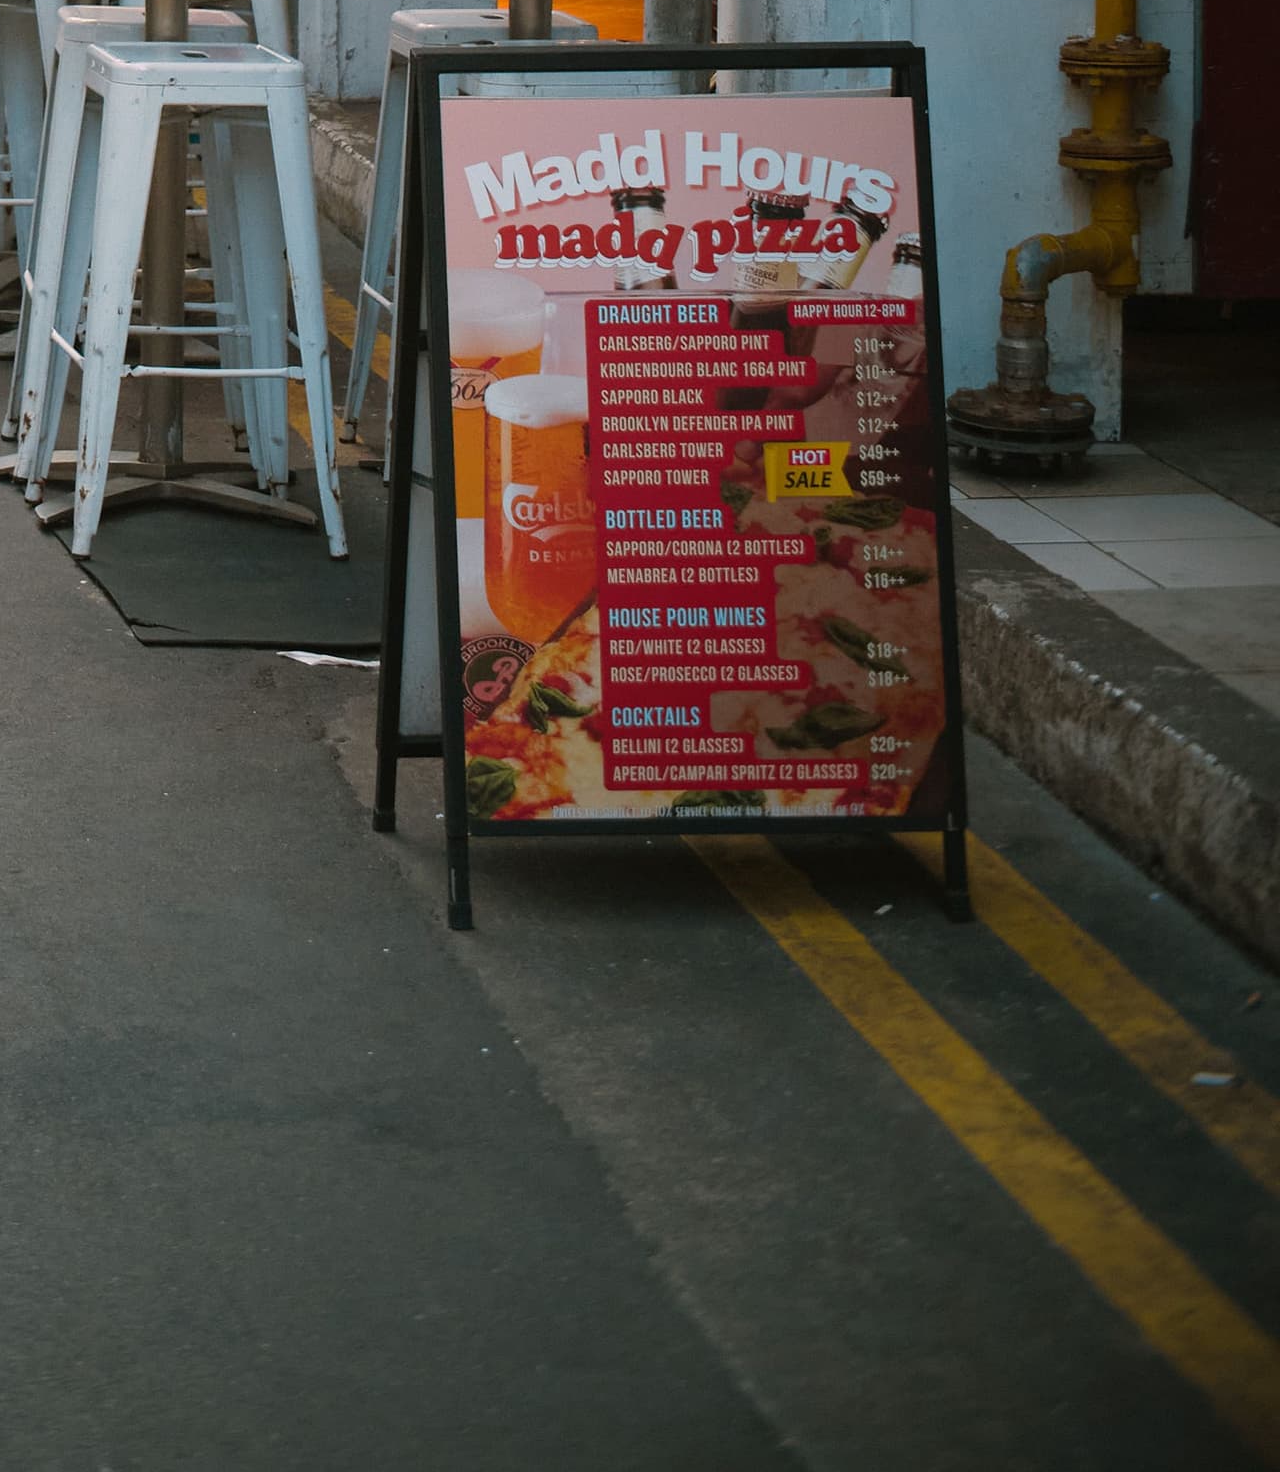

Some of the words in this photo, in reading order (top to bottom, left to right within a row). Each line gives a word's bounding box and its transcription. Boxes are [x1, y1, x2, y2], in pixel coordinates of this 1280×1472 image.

[464, 130, 667, 220] Madd
[686, 131, 895, 213] Hours
[495, 211, 685, 275] madd
[690, 205, 861, 280] pizza
[598, 304, 671, 324] DRAUGHT
[678, 304, 718, 323] BEER
[794, 304, 829, 318] HAPPY
[599, 335, 737, 351] CARLSBERG/SAPPORO
[741, 335, 769, 349] PINT
[854, 338, 895, 354] $10++
[600, 362, 692, 378] KRONENBOURG
[697, 362, 737, 377] BLANC
[742, 361, 775, 376] 1664
[778, 361, 806, 376] PINT
[855, 364, 896, 380] $10++
[601, 389, 659, 405] SAPPORO
[663, 389, 703, 404] BLACK
[856, 391, 897, 407] $12++
[602, 417, 668, 432] BROOKLYN
[672, 416, 737, 432] DEFENDER
[741, 415, 762, 431] IPA
[766, 415, 794, 430] PINT
[858, 418, 899, 434] $12++
[603, 443, 676, 458] CARLSBERG
[680, 442, 724, 458] TOWER
[791, 450, 827, 464] HOT
[859, 445, 900, 461] $49++
[603, 469, 662, 486] SAPPORO
[666, 469, 710, 485] TOWER
[784, 471, 832, 488] SALE
[860, 471, 901, 487] $59++
[605, 510, 677, 529] BOTTLED
[681, 509, 723, 529] BEER
[606, 540, 723, 556] SAPPORO/CORONA
[744, 539, 804, 555] BOTTLES)
[863, 545, 904, 561] $14++
[607, 568, 677, 584] MENABREA
[699, 567, 759, 583] BOTTLES)
[609, 608, 661, 627] HOUSE
[667, 608, 709, 627] POUR
[714, 607, 766, 626] WINES
[610, 639, 682, 655] RED/WHITE
[704, 638, 765, 654] GLASSES)
[610, 666, 716, 682] ROSE/PROSECCO
[739, 665, 799, 681] GLASSES)
[612, 706, 700, 727] COCKTAILS
[613, 738, 661, 754] BELLINI
[683, 737, 744, 753] GLASSES)
[870, 736, 911, 752] $20++
[613, 765, 727, 781] APEROL/CAMPARI
[731, 765, 776, 781] SPRITZ
[797, 763, 858, 779] GLASSES)
[871, 764, 912, 780] $20++
